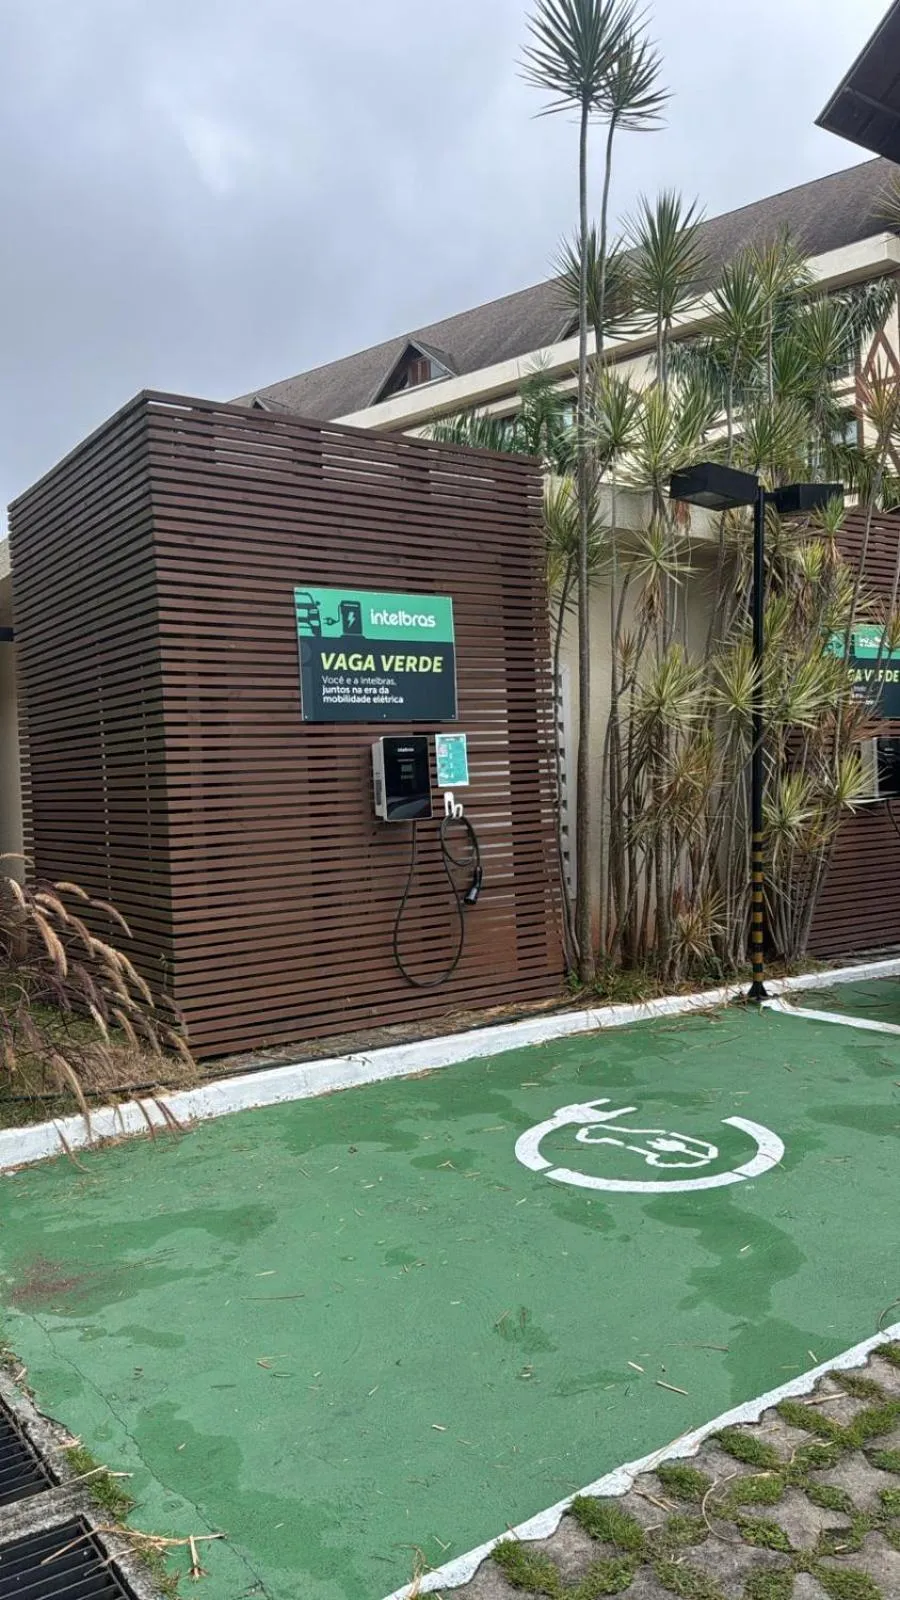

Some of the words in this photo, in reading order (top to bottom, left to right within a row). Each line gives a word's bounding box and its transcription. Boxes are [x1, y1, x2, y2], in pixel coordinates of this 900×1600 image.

[370, 608, 436, 628] intelbras
[320, 652, 376, 671] VAGA
[380, 654, 443, 673] VERDE
[321, 675, 345, 685] Você
[322, 685, 350, 695] juntos
[379, 686, 390, 694] da
[323, 695, 371, 704] mobilidade
[373, 695, 404, 704] elétrica
